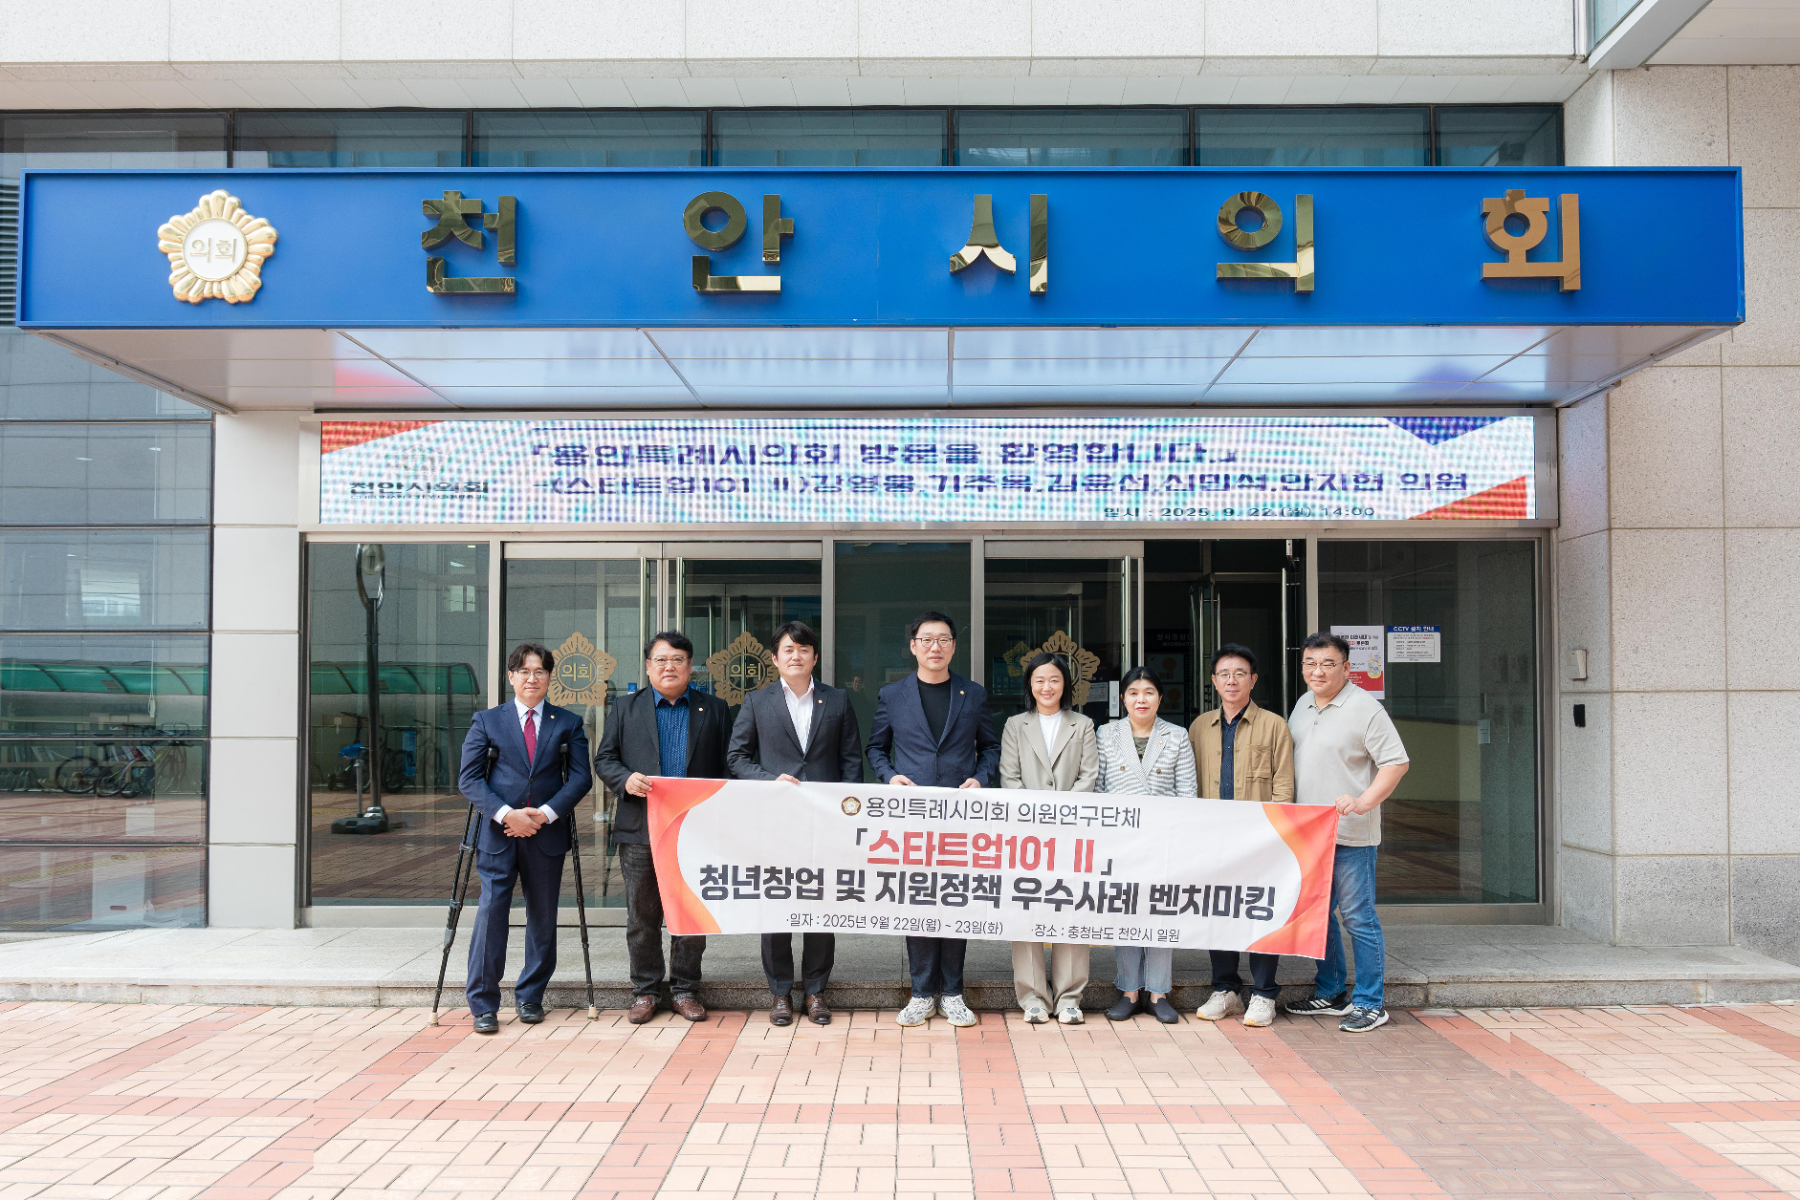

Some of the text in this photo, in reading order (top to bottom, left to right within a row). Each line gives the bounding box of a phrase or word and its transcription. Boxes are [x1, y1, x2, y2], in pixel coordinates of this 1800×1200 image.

[189, 235, 237, 265] 의회
[561, 662, 593, 682] 의회
[730, 662, 761, 681] 의회
[866, 797, 1141, 829] 용인특례시의회 의원연구단체
[699, 864, 1276, 922] 청년창업 및 지원정책 우수사례 벤치마킹
[822, 913, 867, 929] 2025년
[870, 915, 890, 930] 9월
[893, 917, 942, 933] 22일(월)
[955, 920, 1003, 936] 23일(화)
[1067, 925, 1115, 940] 충청남도
[1118, 927, 1153, 942] 천안시
[1156, 928, 1181, 943] 일원
